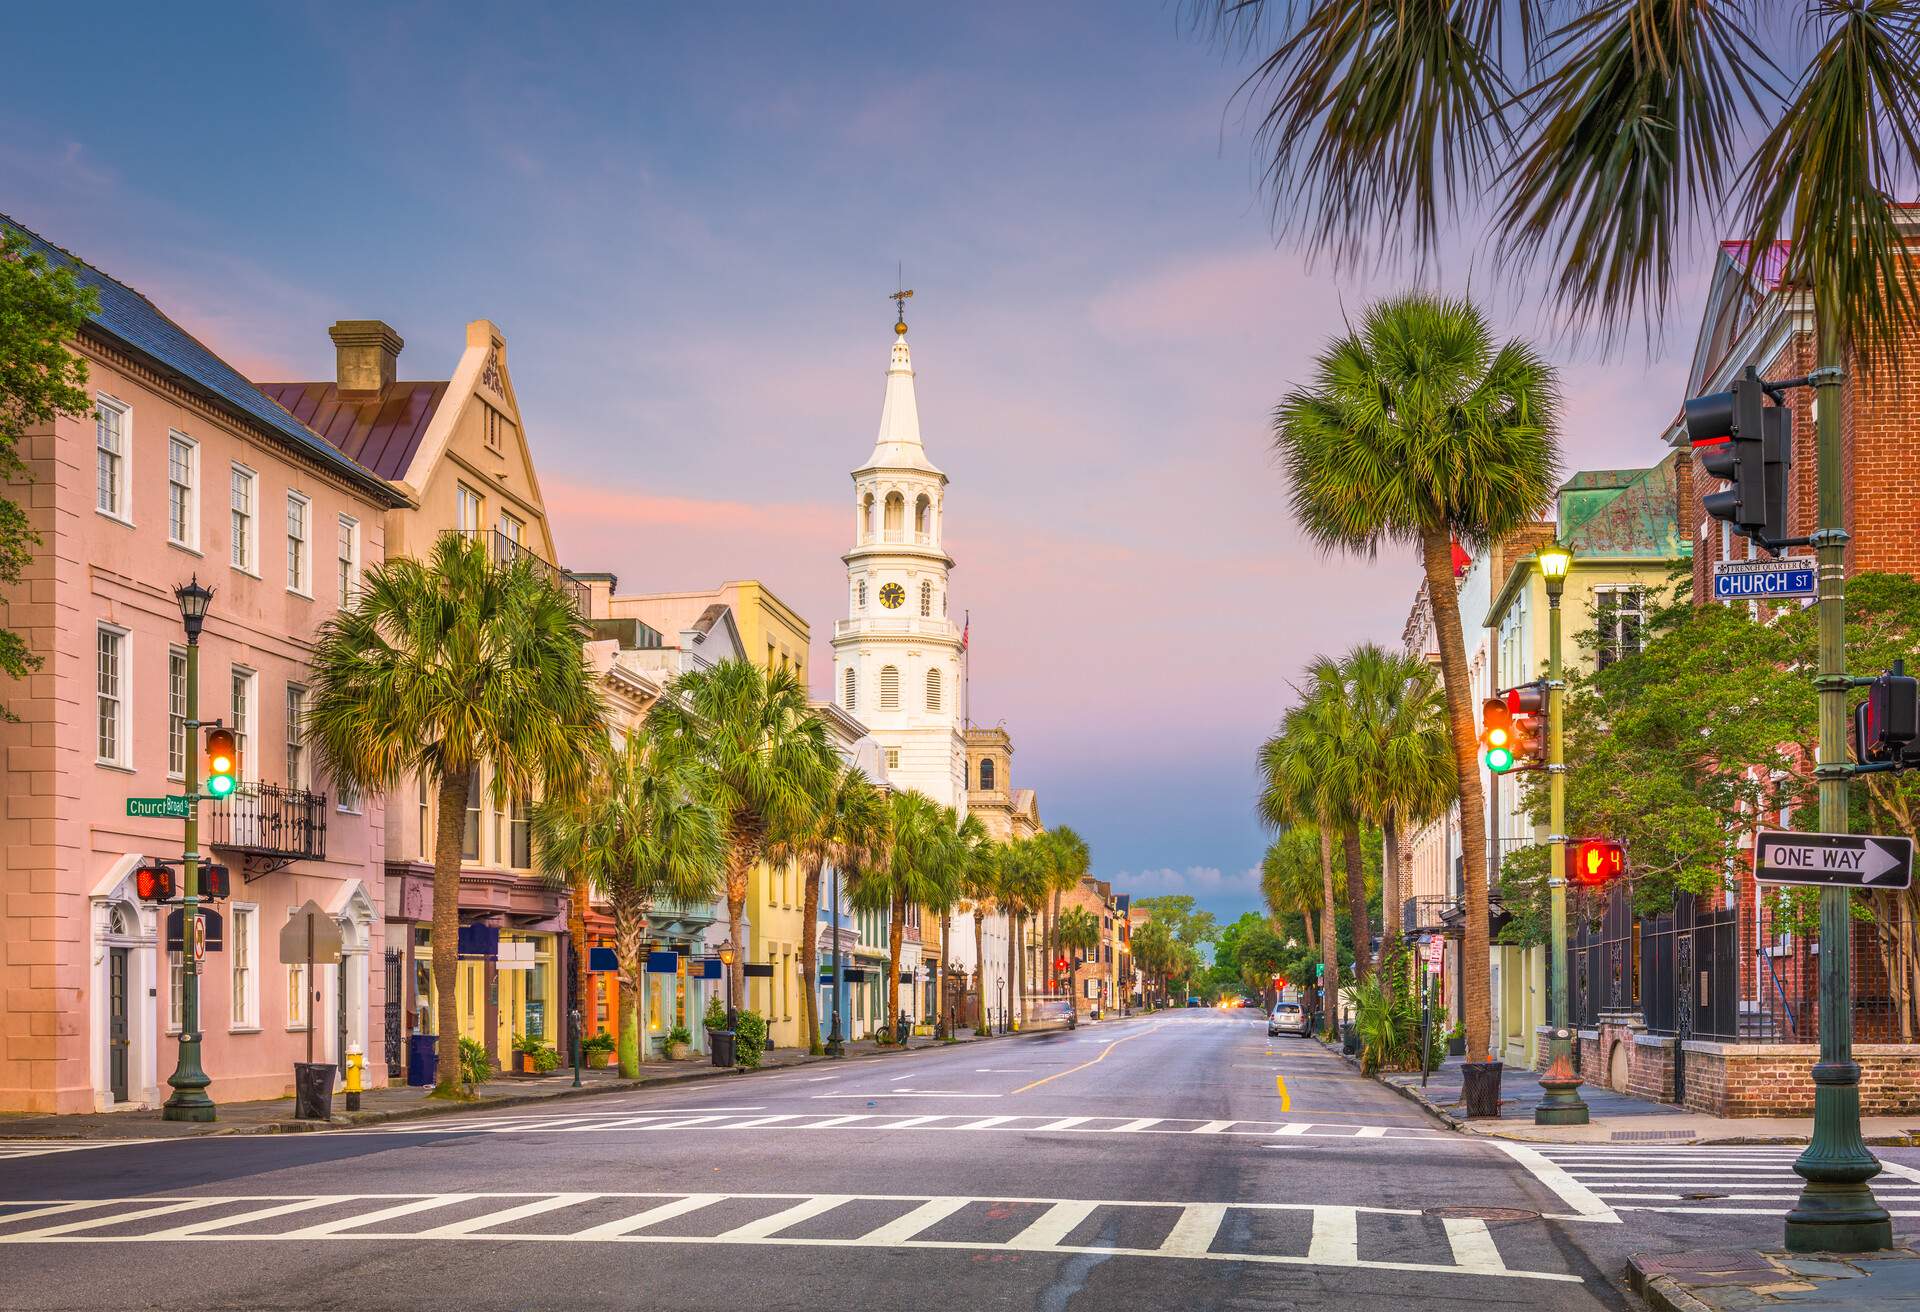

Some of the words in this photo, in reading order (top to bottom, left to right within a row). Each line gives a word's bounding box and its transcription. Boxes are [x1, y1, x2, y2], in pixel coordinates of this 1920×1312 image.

[1731, 563, 1760, 573] FRENCH
[1762, 561, 1798, 571] QUARTER
[1719, 573, 1787, 594] CHURCH
[1796, 575, 1809, 587] ST
[166, 797, 184, 812] Broad
[1610, 850, 1620, 871] 4
[1774, 847, 1814, 867] ONE
[1823, 849, 1865, 869] WAY
